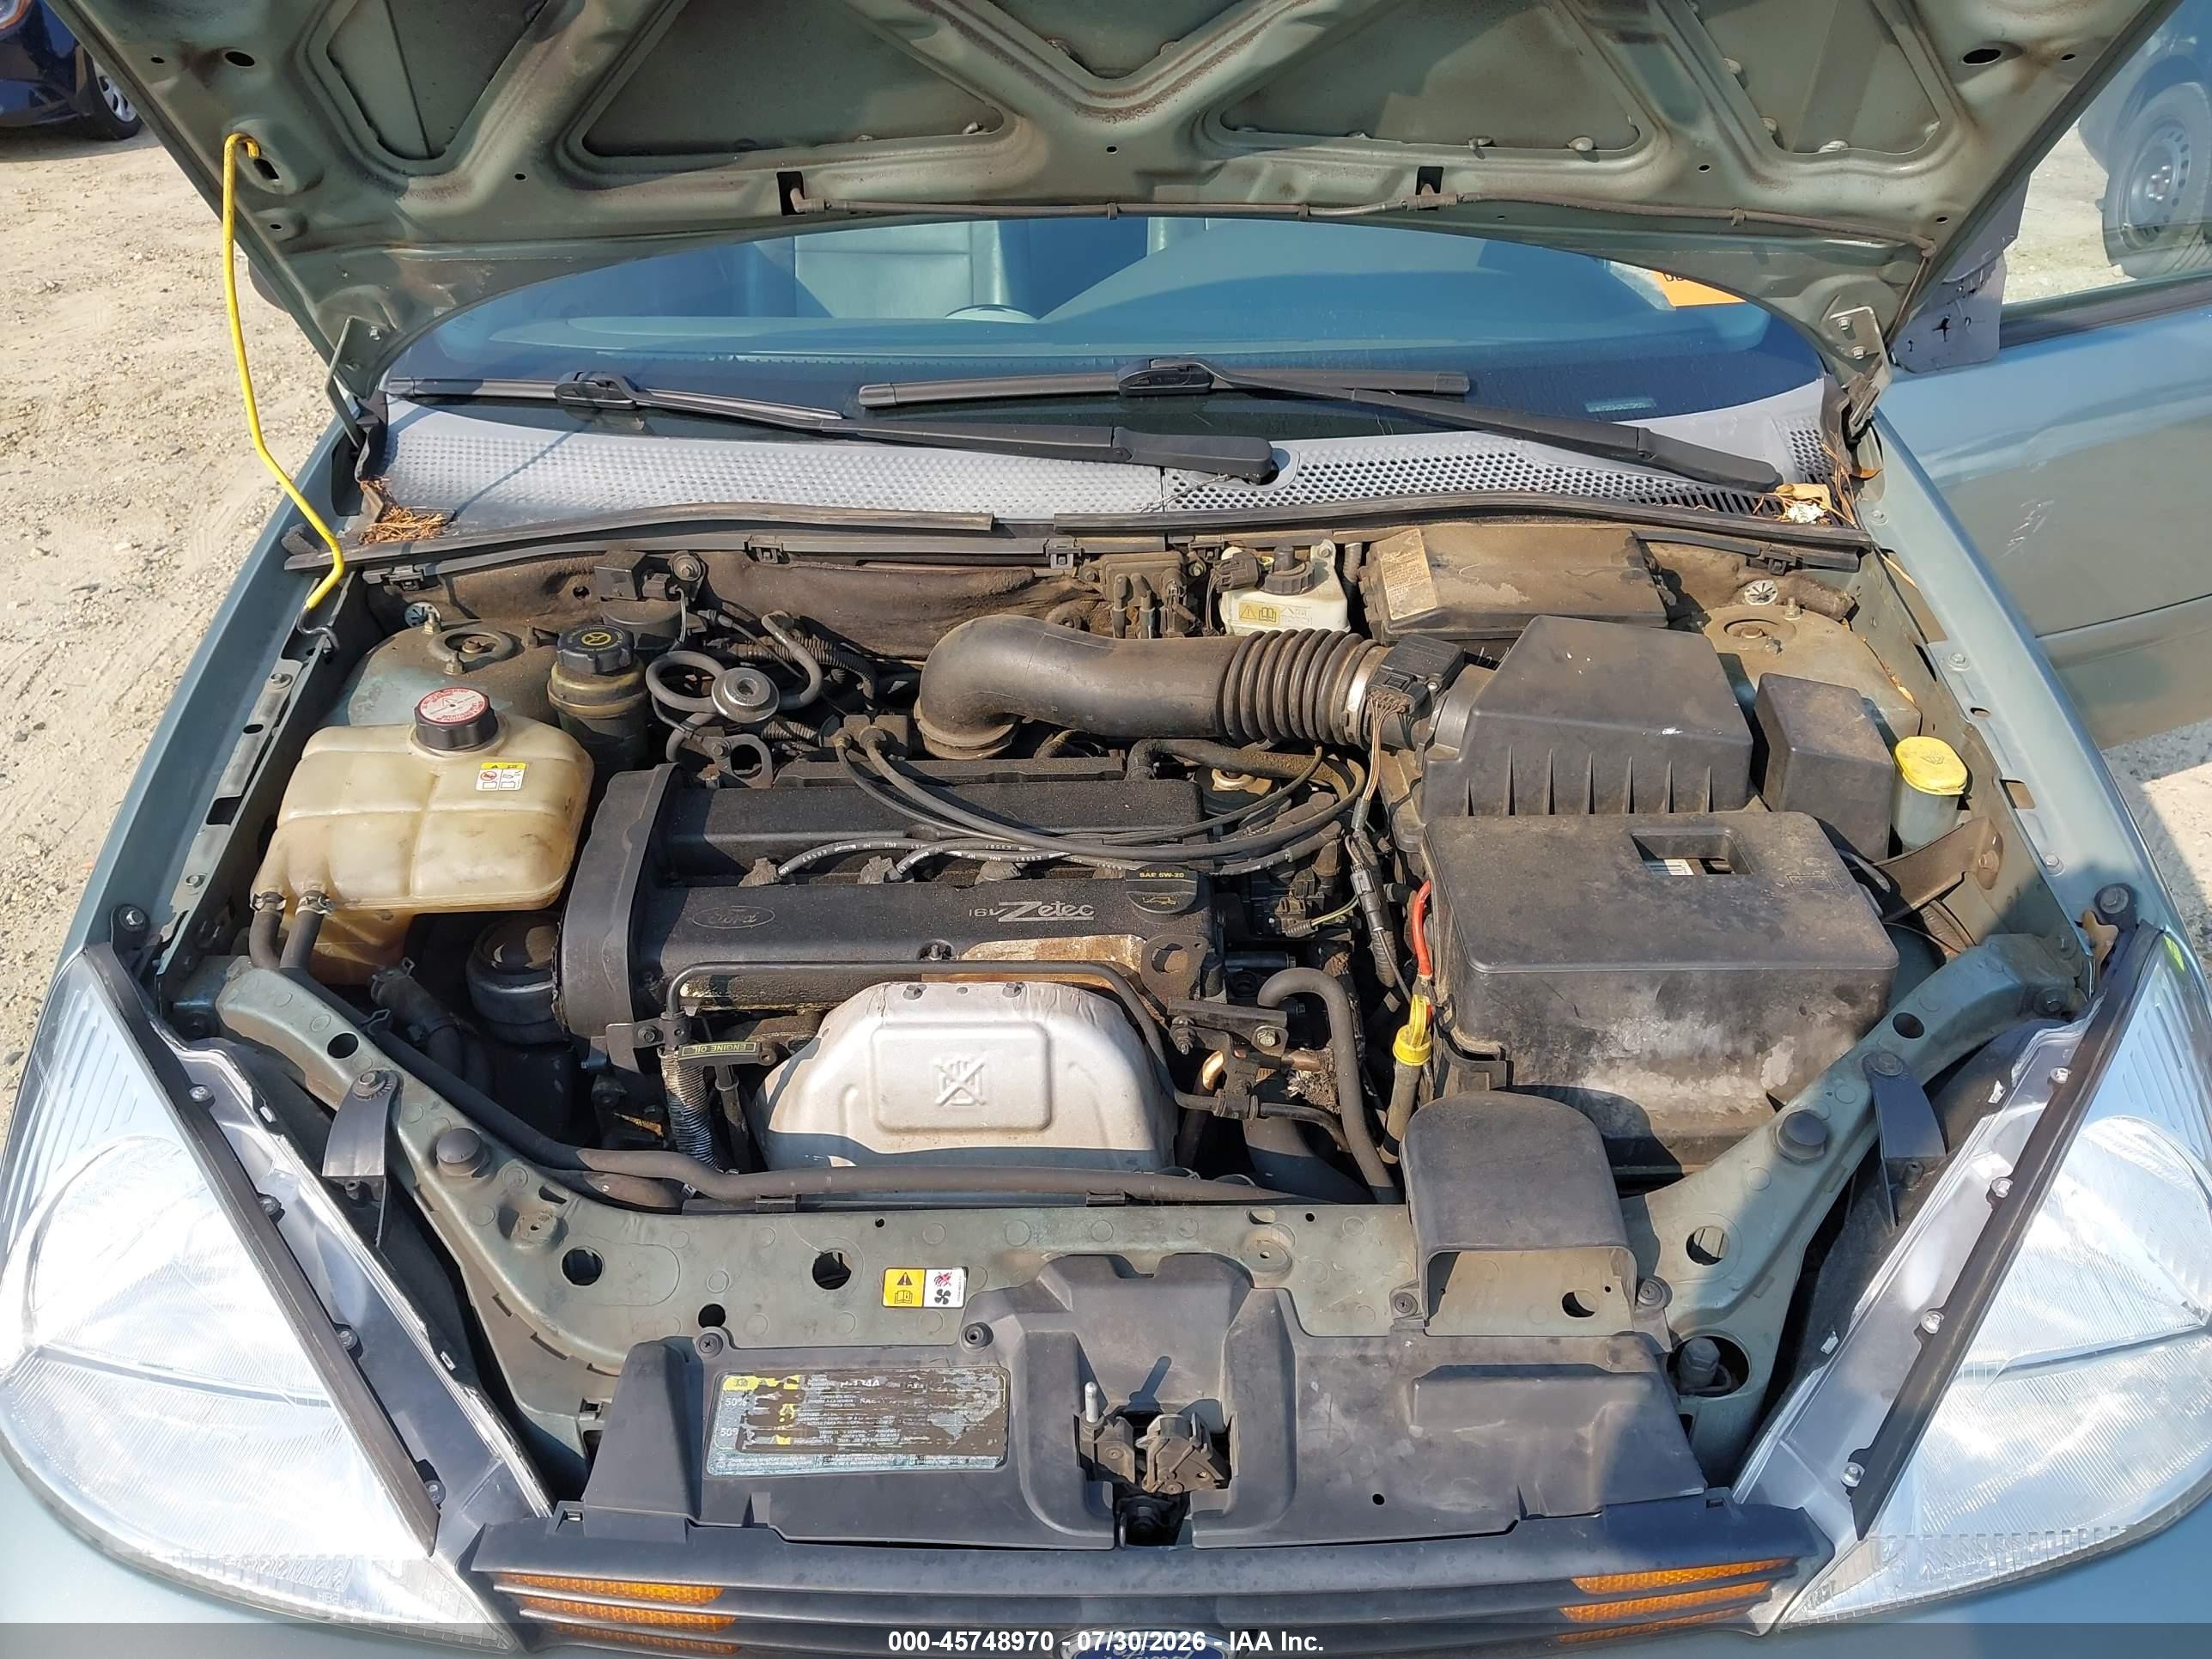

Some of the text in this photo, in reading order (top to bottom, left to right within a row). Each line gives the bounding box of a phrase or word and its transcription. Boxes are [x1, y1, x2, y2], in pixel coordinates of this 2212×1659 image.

[998, 900, 1095, 922] Zetec
[711, 1043, 746, 1052] ENGINE
[725, 1397, 747, 1407] 50%
